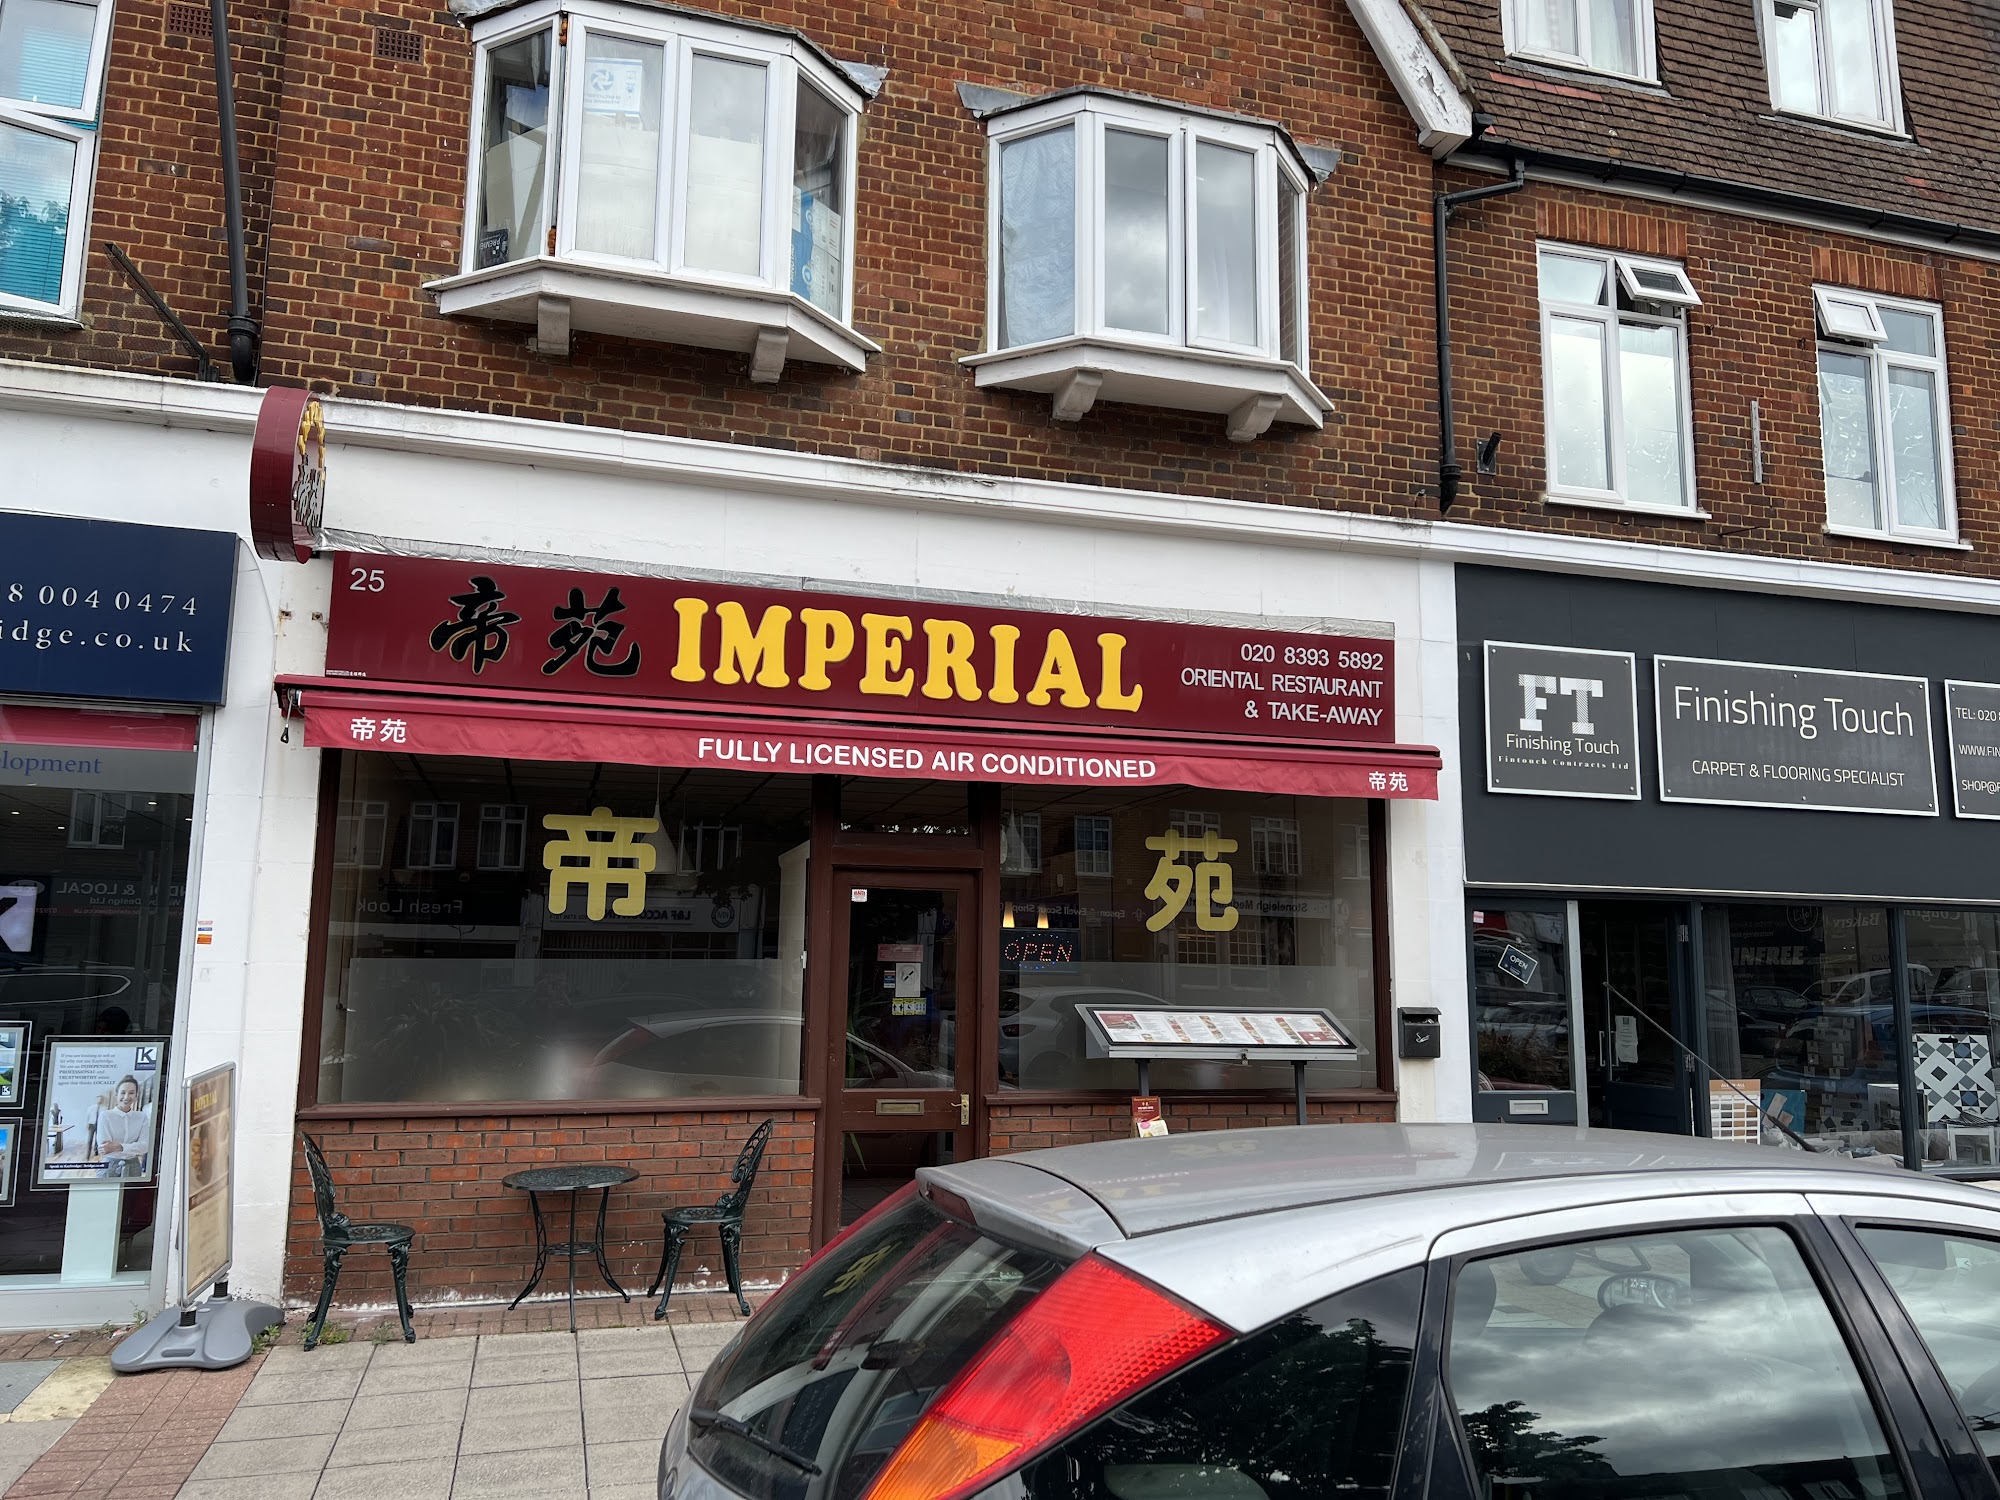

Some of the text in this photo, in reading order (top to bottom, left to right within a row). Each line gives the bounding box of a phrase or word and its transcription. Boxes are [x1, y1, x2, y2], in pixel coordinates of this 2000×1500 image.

[349, 567, 385, 593] 25
[38, 585, 100, 609] 004
[114, 591, 197, 616] 0474
[428, 575, 641, 677] 帝苑
[670, 597, 1144, 713] IMPERIAL
[1241, 643, 1384, 671] 020 8393 5892
[1181, 667, 1384, 699] ORIENTAL RESTAURANT
[1244, 700, 1384, 726] & TAKE-AWAY
[1518, 673, 1604, 736] FT
[1674, 685, 1914, 740] Finishing Touch
[1955, 707, 1997, 722] TEL: 020
[350, 716, 407, 744] 帝苑
[698, 737, 1156, 779] FULLY LICENSED AIR CONDITIONED
[1506, 733, 1620, 756] Finishing Touch
[1498, 755, 1629, 770] Fintouch Contracts Ltd
[1692, 760, 1905, 787] CARPET & FLOORING SPECIALIST
[1368, 771, 1409, 793] 帝苑
[542, 806, 659, 921] 帝
[1144, 828, 1239, 932] 苑
[1004, 943, 1073, 962] OPEN
[1510, 955, 1529, 970] OPEN
